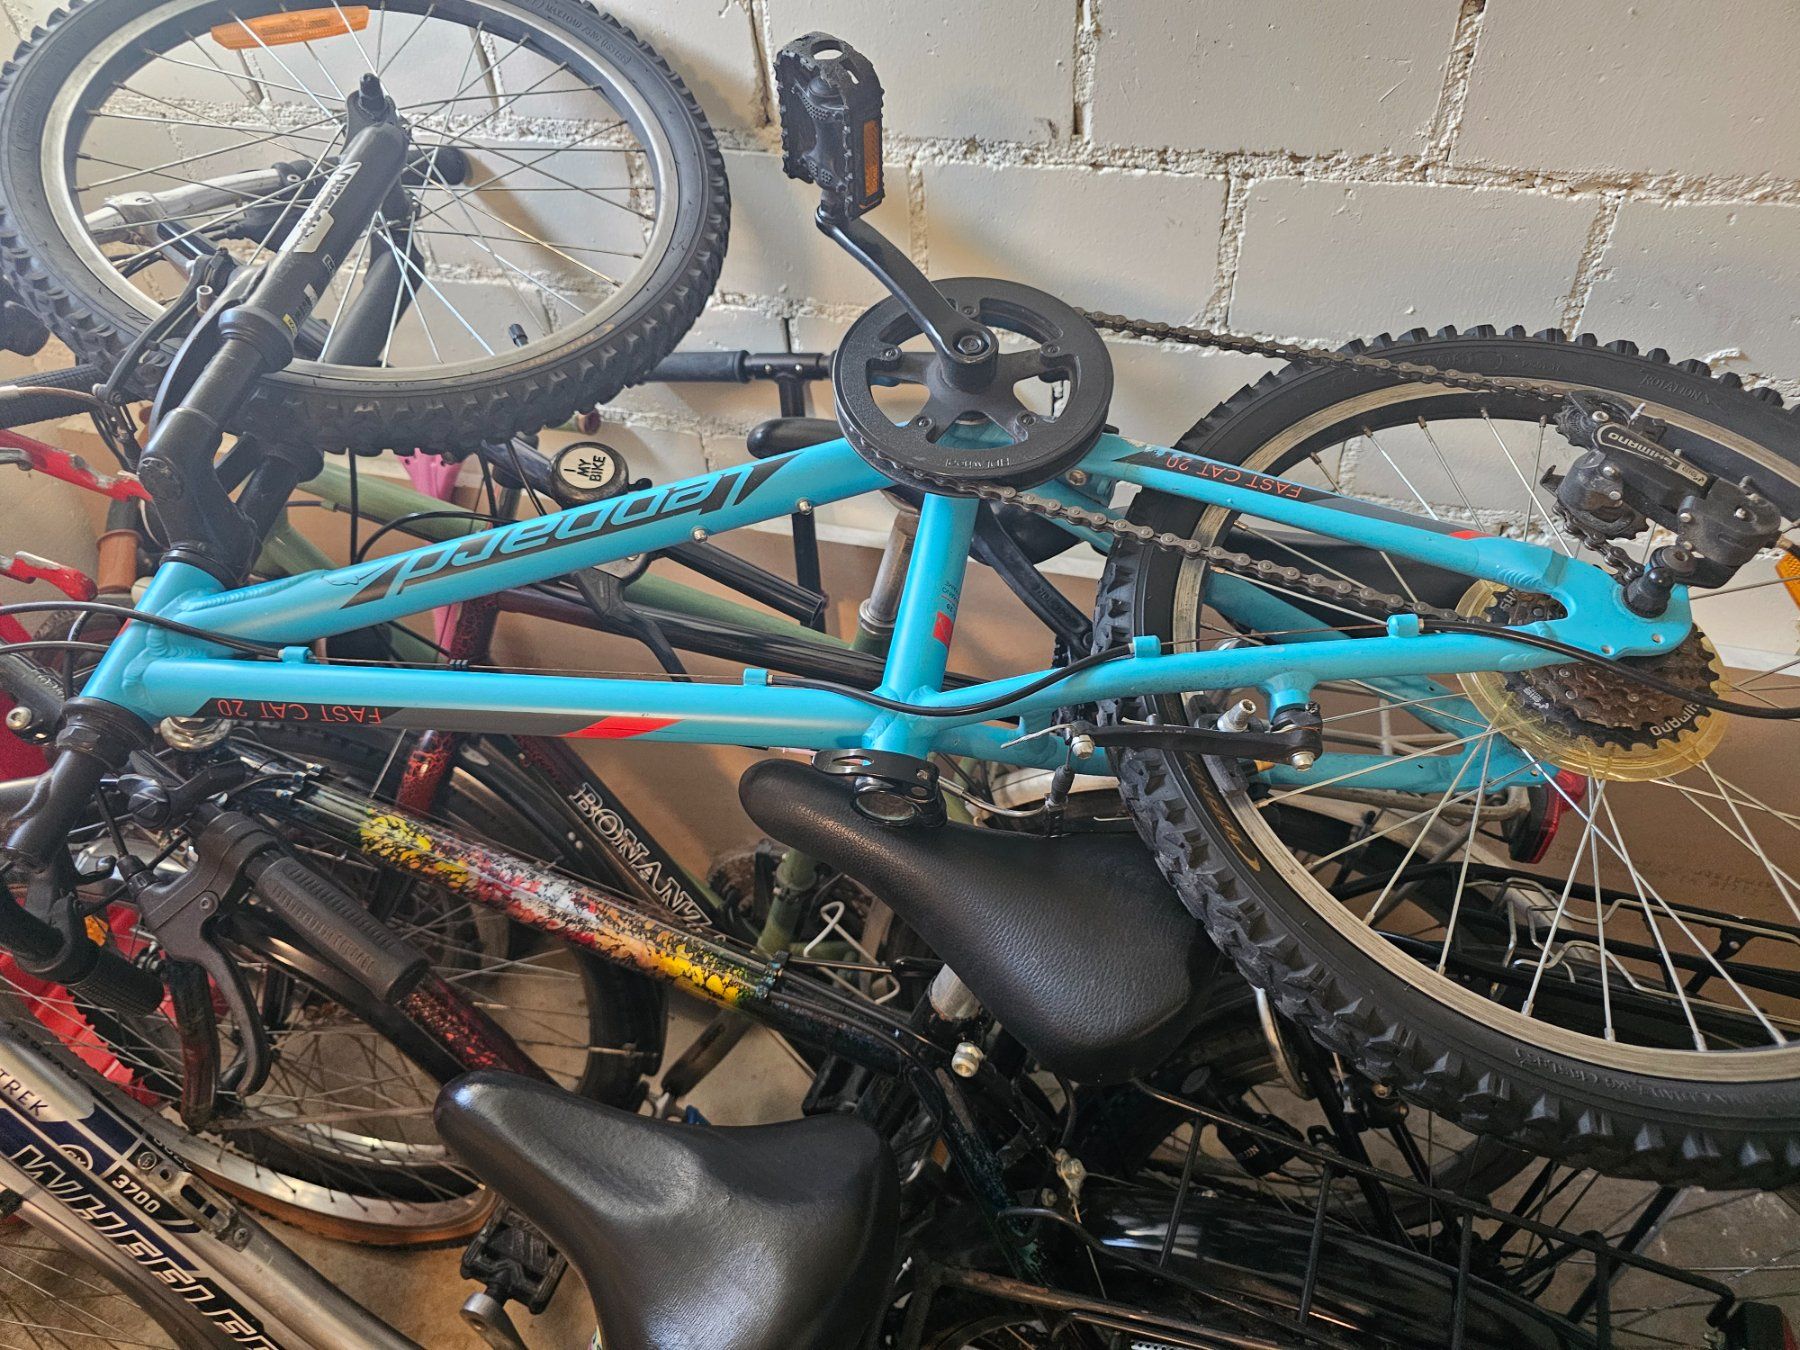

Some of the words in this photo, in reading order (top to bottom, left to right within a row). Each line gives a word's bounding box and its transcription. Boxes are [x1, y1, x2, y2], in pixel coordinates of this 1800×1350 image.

[576, 458, 592, 477] MY
[588, 455, 606, 482] BIKE
[1165, 455, 1191, 471] 20
[1196, 462, 1241, 483] CAT
[1245, 474, 1303, 499] FAST
[216, 699, 249, 717] 20
[259, 701, 309, 720] CAT
[319, 704, 383, 724] FAST
[1649, 703, 1701, 737] HIMANO
[568, 781, 714, 928] BONANZ
[0, 1068, 49, 1117] TREK
[111, 1173, 161, 1214] 3700
